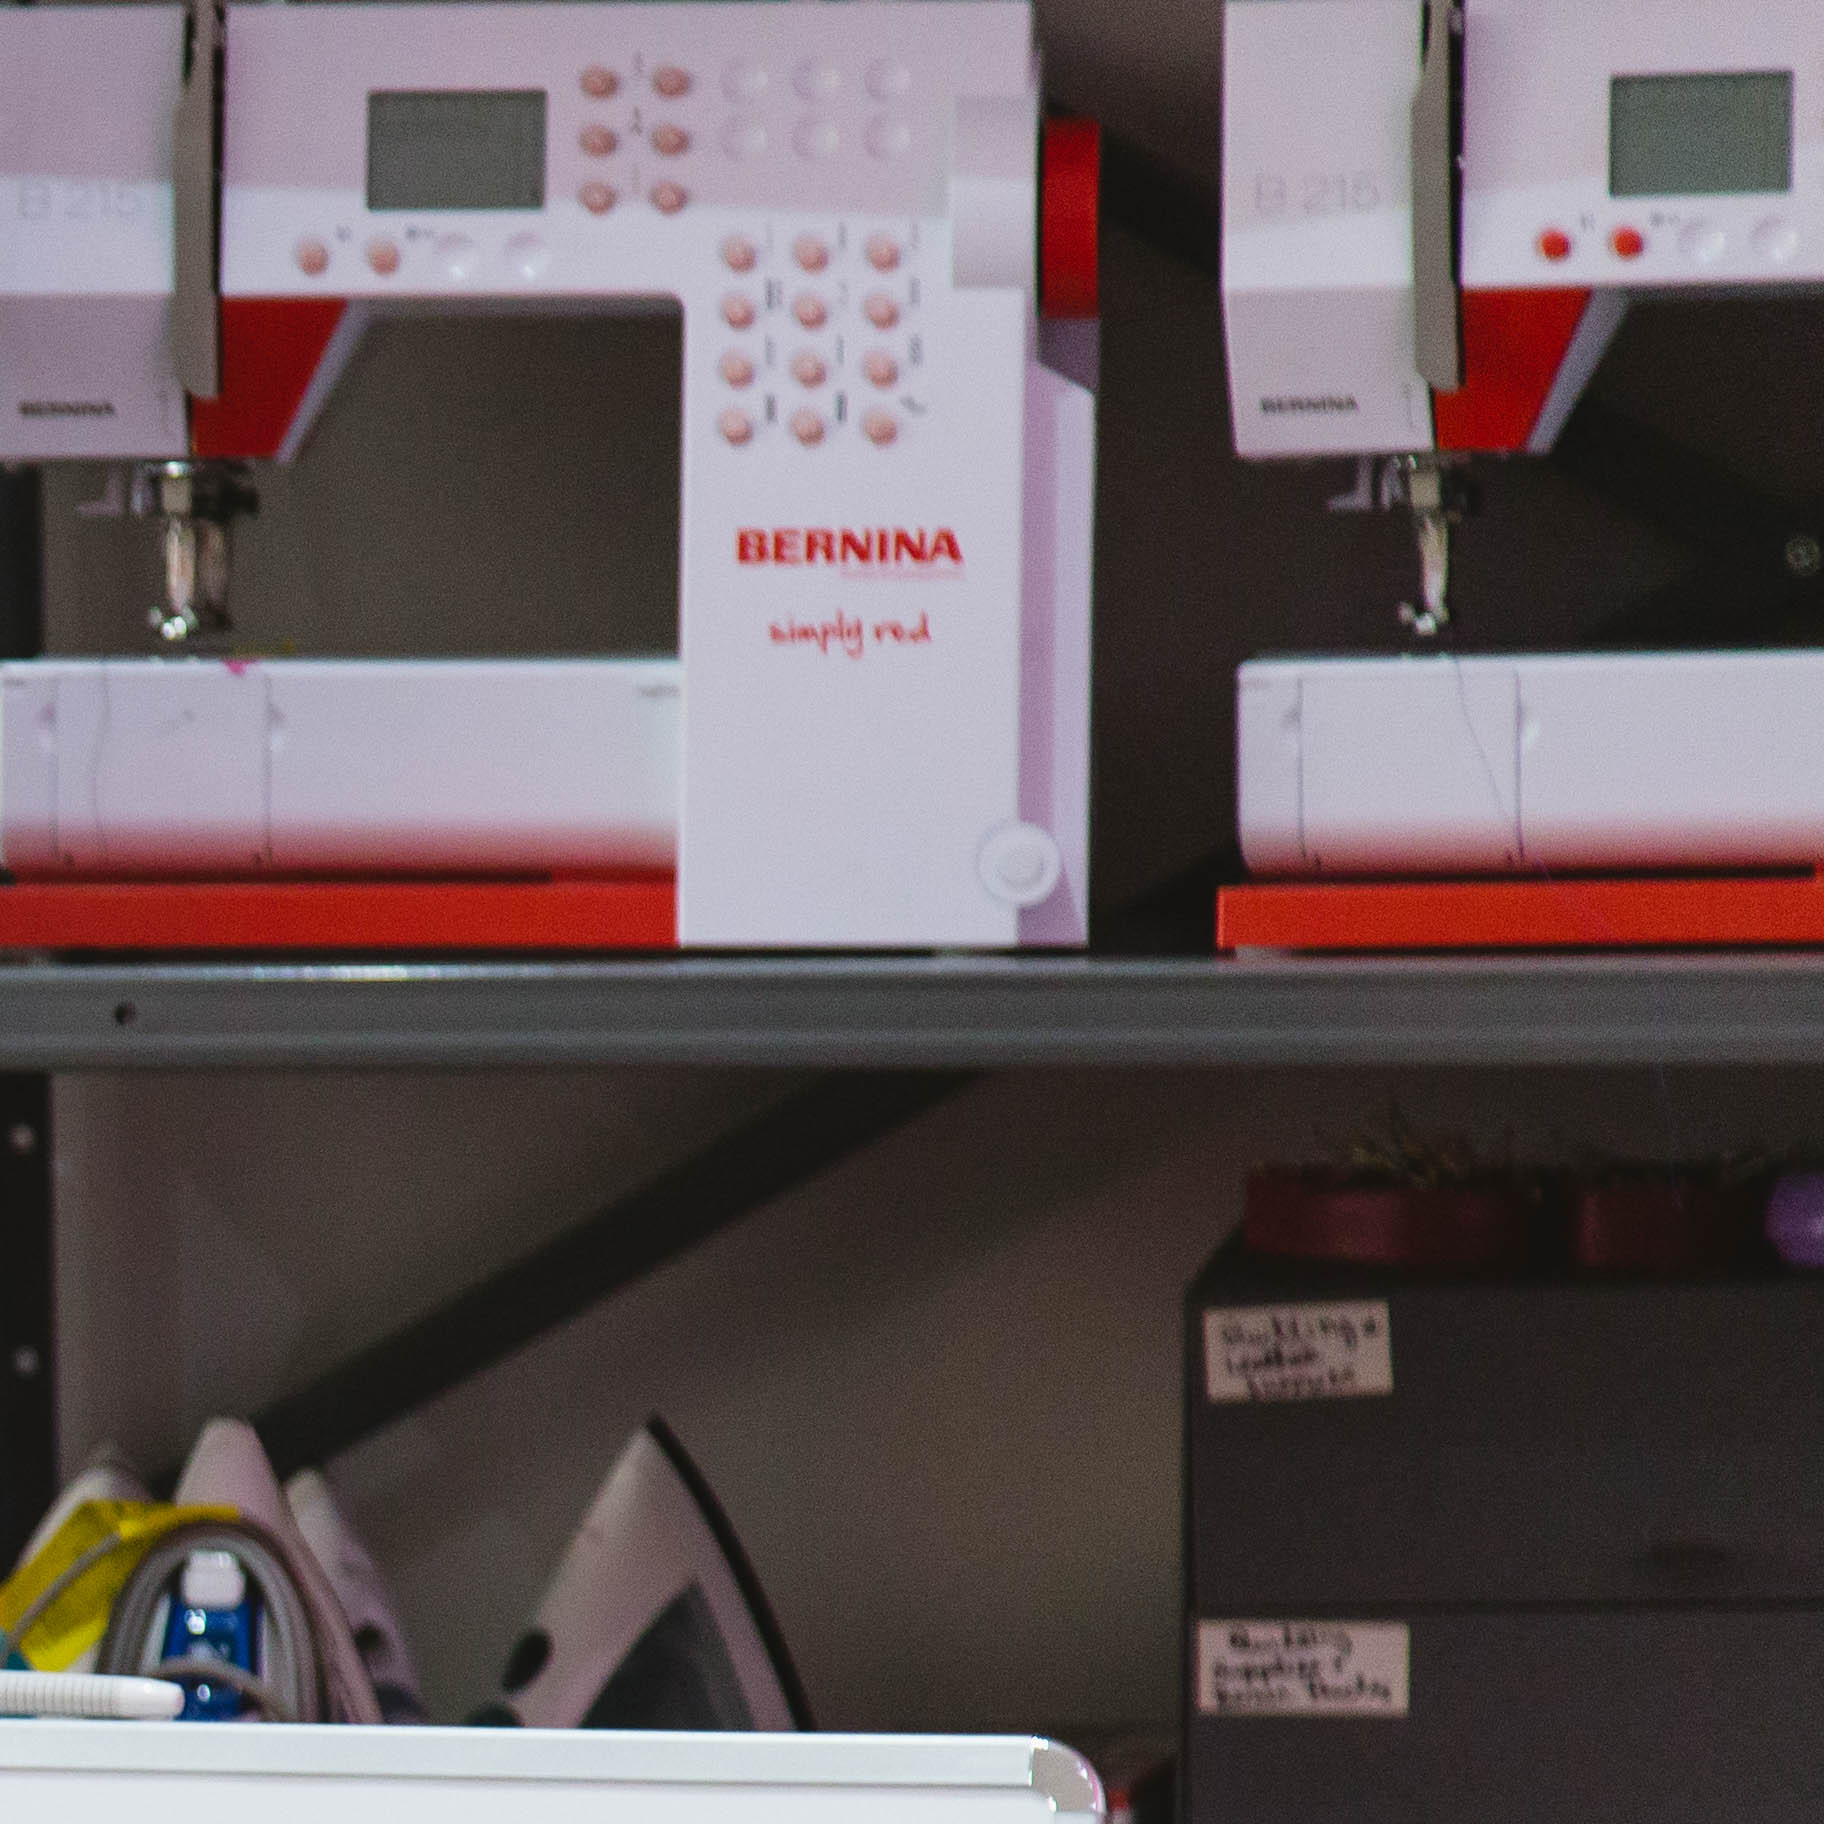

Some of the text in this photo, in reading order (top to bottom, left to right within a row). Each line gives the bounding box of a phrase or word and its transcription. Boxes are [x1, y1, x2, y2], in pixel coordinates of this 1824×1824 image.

[19, 401, 117, 418] BERNINA
[1259, 395, 1360, 416] BERNINA
[735, 528, 964, 565] BERNINA
[768, 609, 933, 659] simply red
